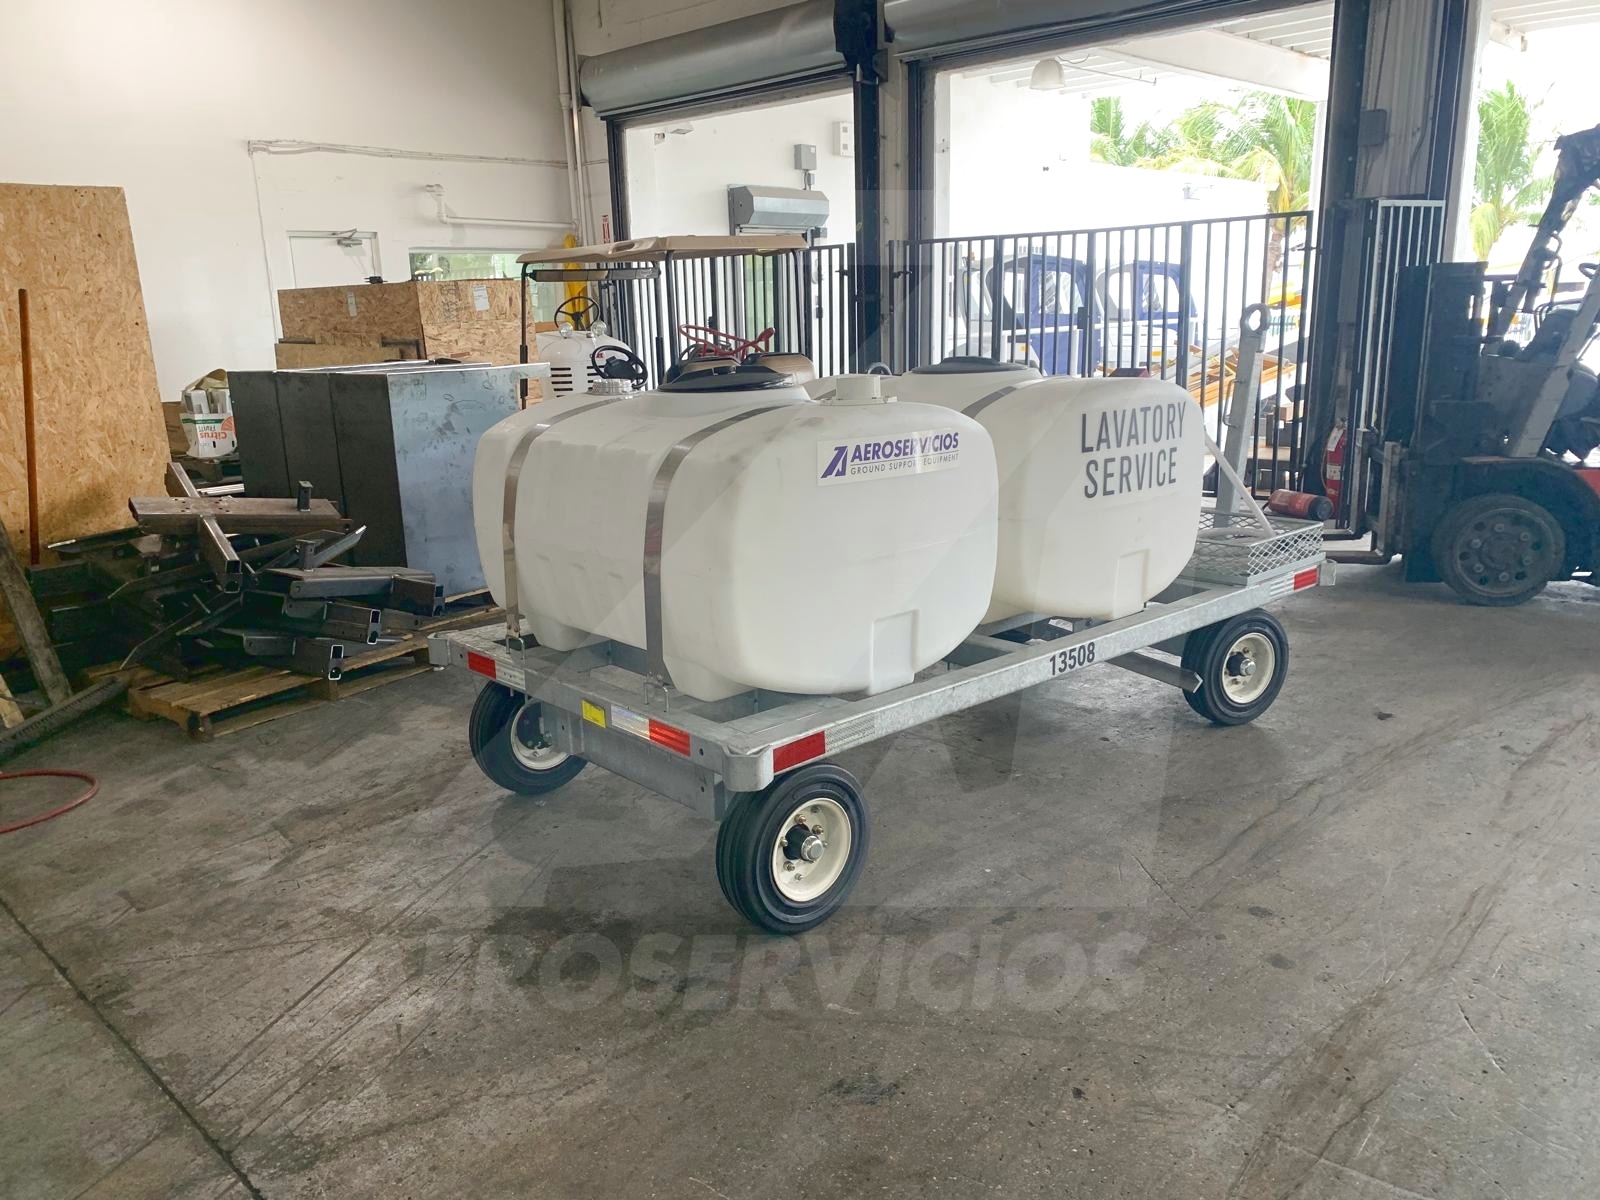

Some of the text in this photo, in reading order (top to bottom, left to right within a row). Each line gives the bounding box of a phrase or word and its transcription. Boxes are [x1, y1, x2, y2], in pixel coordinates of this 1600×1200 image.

[199, 431, 227, 440] Citrus
[1081, 401, 1186, 453] LAVATORY
[850, 432, 959, 462] AEROSERVICIOS
[851, 453, 959, 475] GROUND SUPPO EQUIPMENT
[1084, 447, 1177, 498] SERVICE
[1050, 642, 1095, 676] 13508
